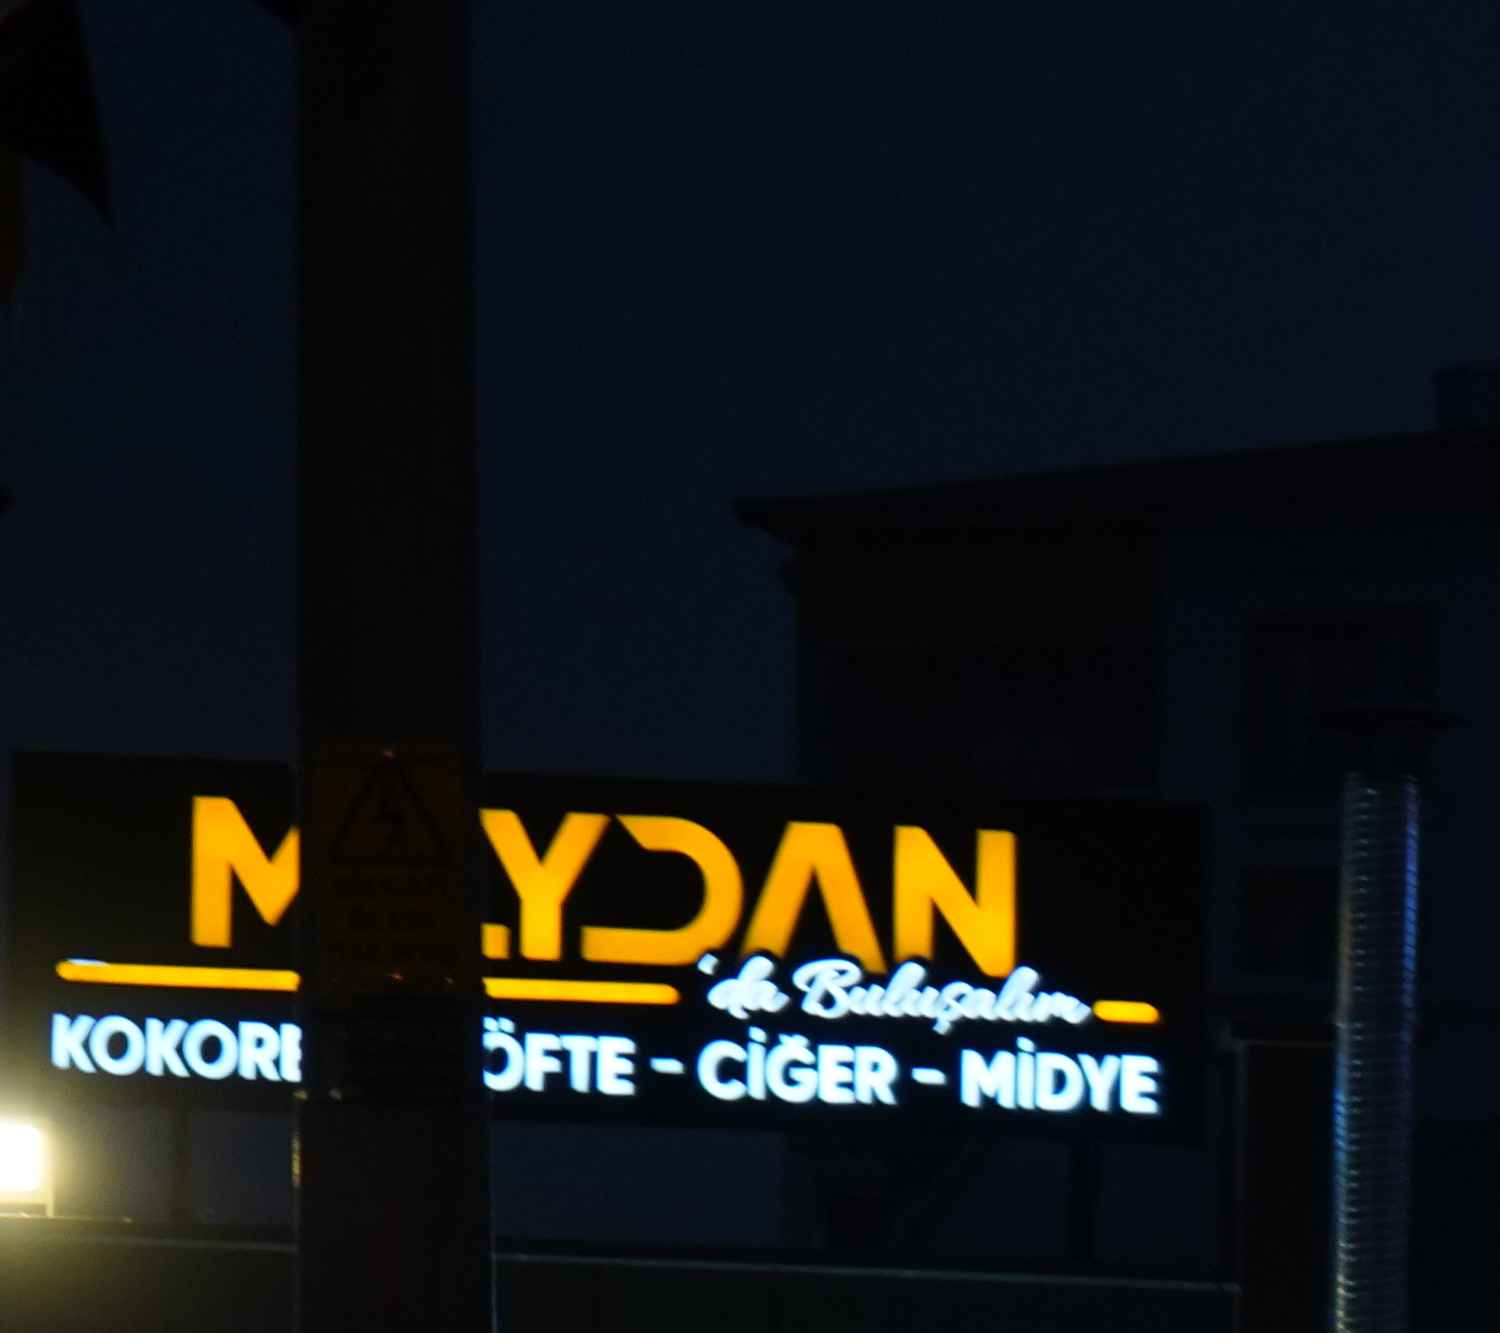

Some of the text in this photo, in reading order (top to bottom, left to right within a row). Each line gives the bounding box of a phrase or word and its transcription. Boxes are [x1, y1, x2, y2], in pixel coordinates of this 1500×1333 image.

[190, 795, 1017, 974] MYDAN
[50, 1013, 304, 1085] KOKORE
[481, 1015, 637, 1096] ÖFTE
[697, 1022, 903, 1106] CİĞER
[960, 1033, 1160, 1114] MİDYE
